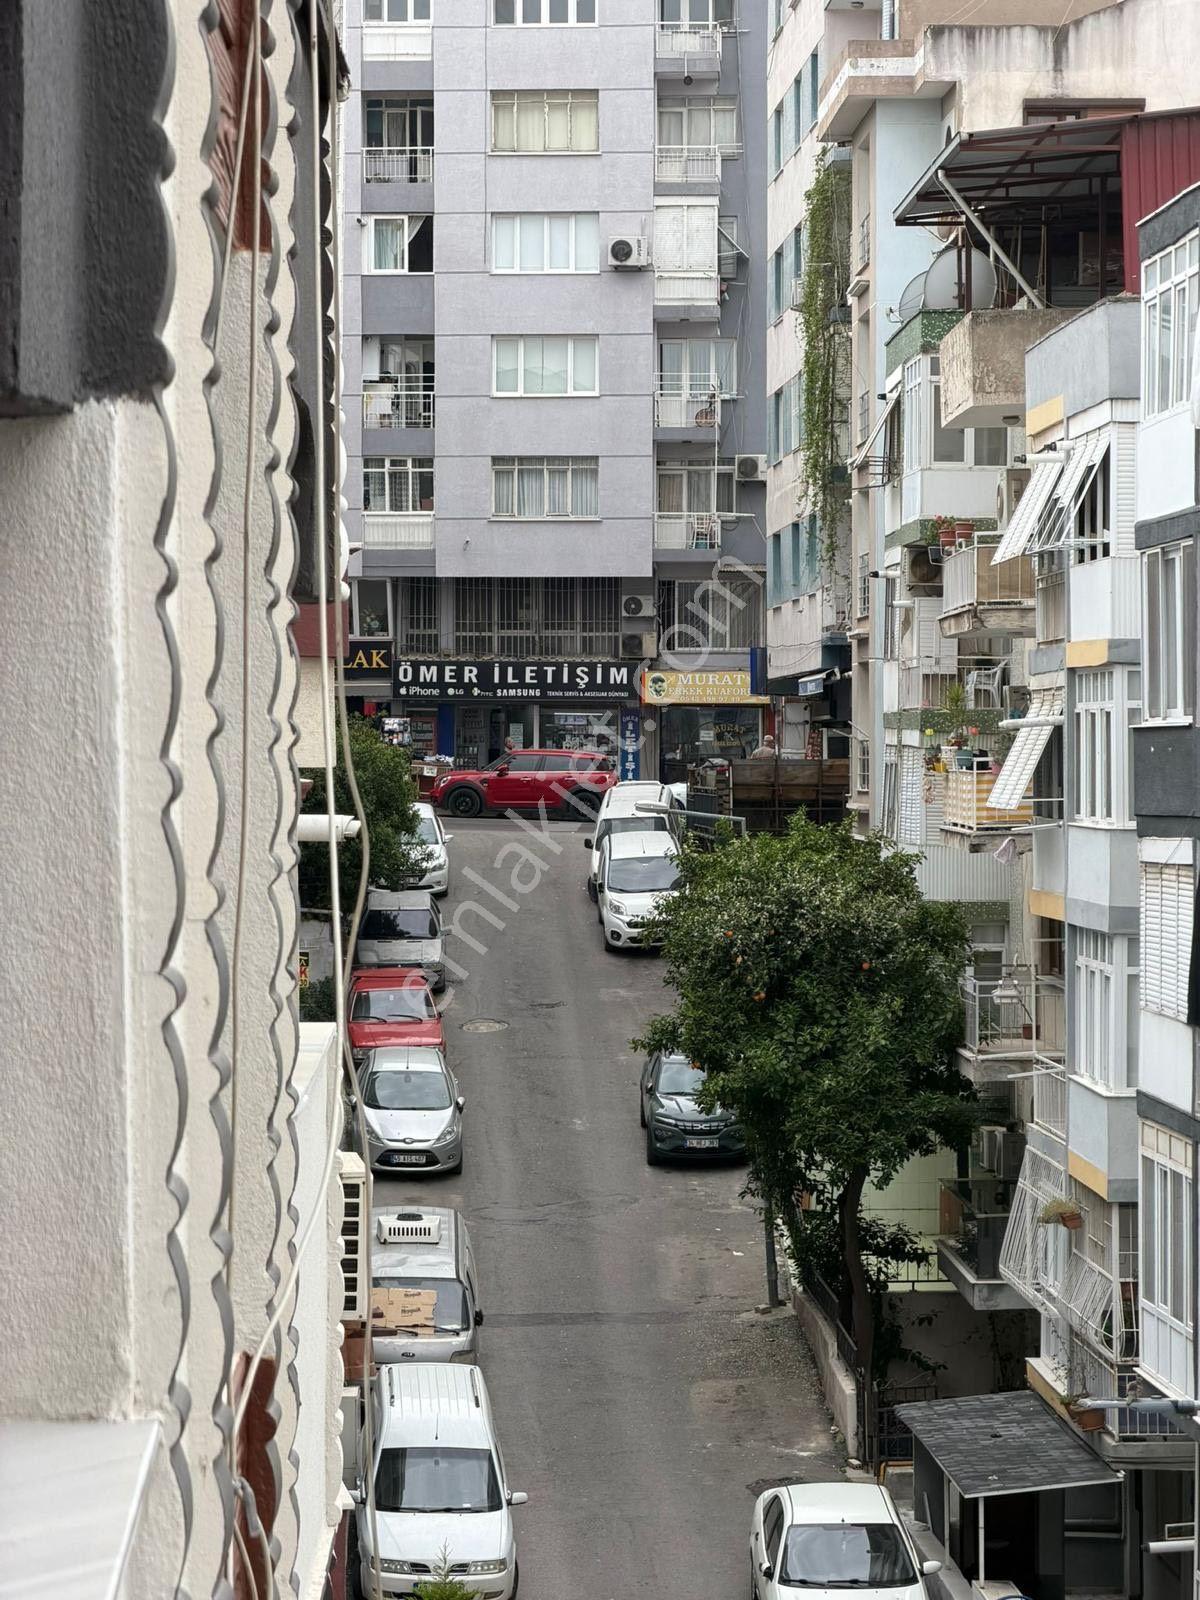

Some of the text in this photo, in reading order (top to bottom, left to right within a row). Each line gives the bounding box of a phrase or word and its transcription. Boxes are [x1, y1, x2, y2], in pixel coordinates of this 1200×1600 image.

[399, 662, 628, 688] ÖMER İLETİŞİM
[678, 673, 745, 685] MURAT
[409, 686, 440, 696] iPhone
[496, 688, 541, 697] SAMSUNG
[668, 687, 702, 696] ERKEK
